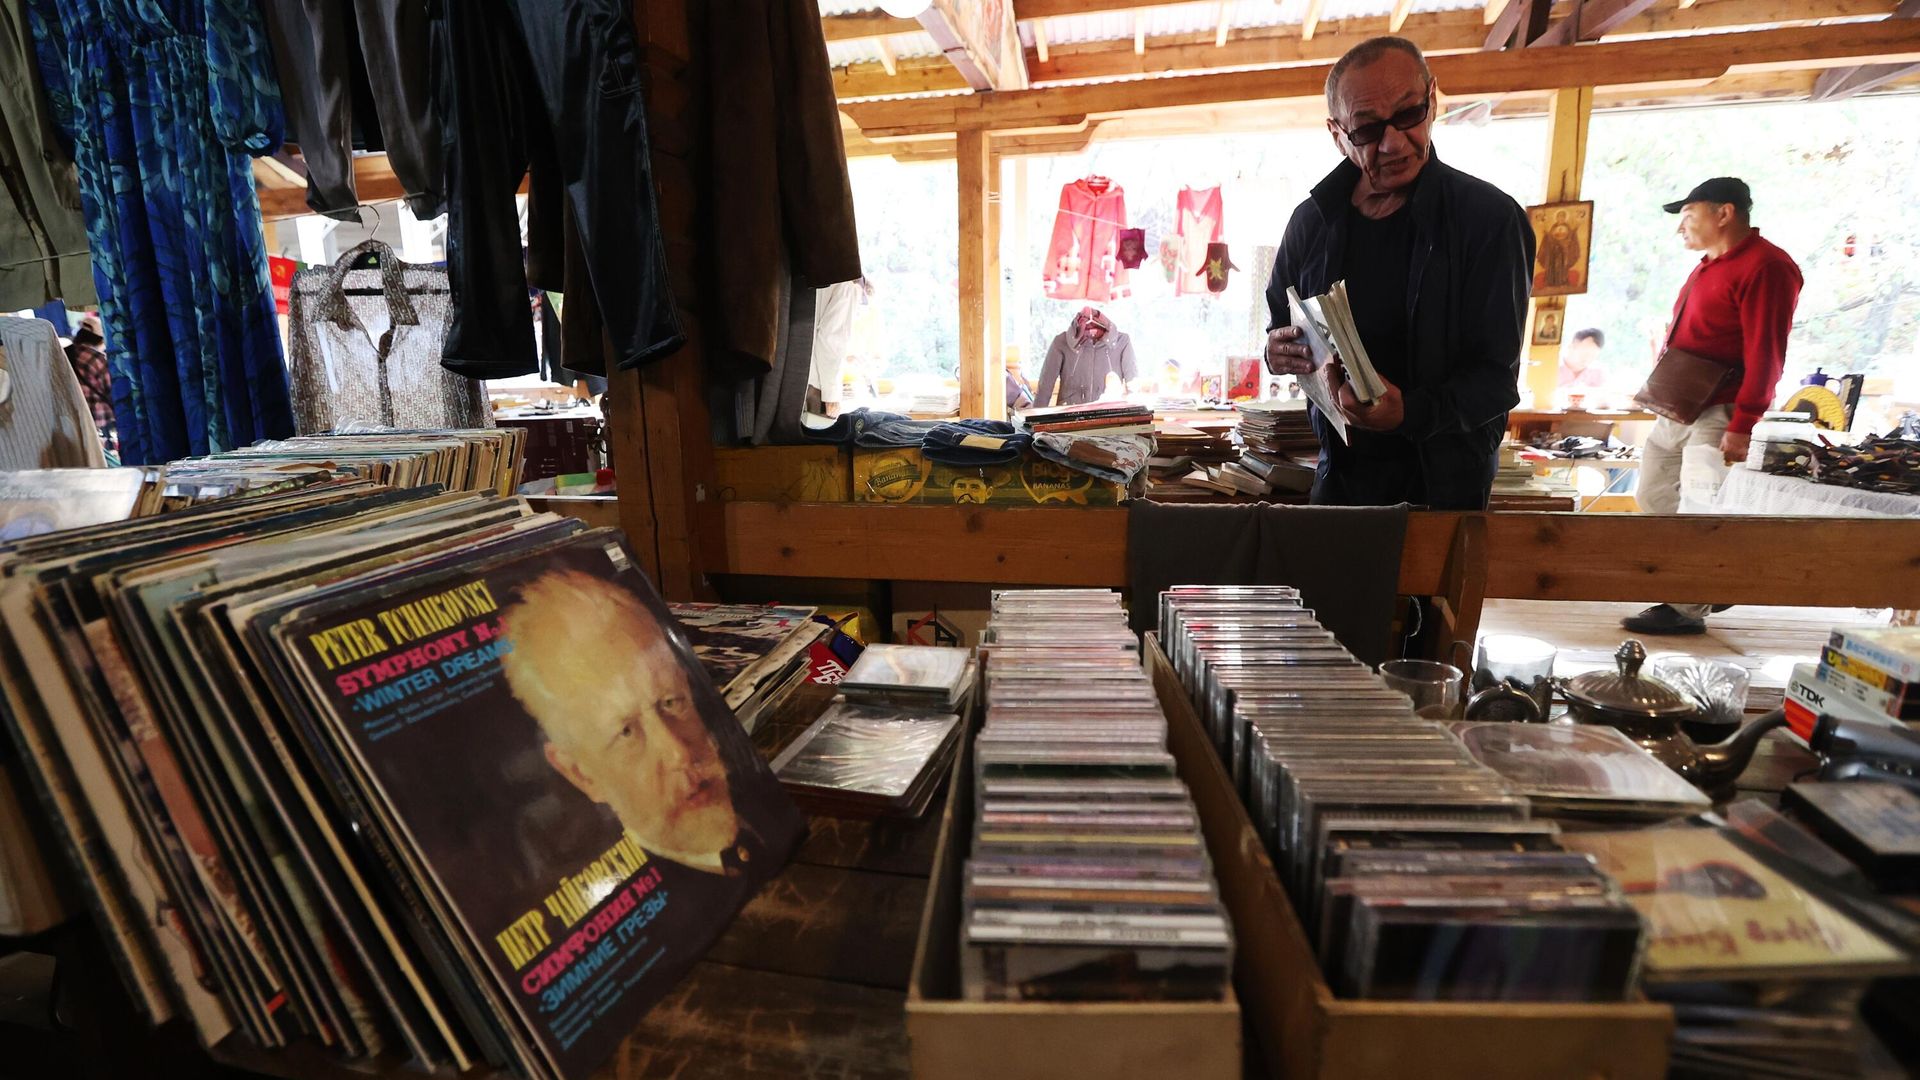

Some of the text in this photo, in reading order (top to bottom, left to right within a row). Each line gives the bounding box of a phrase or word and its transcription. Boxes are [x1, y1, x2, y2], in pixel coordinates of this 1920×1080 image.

[1032, 481, 1071, 490] BANANAS
[309, 579, 498, 670] PETER TCHAIKOVSKY
[337, 631, 468, 696] SYMPHONY
[1799, 683, 1825, 707] TDK
[495, 907, 551, 971] ПЕТР
[521, 885, 637, 995] СИМФОНИЯ
